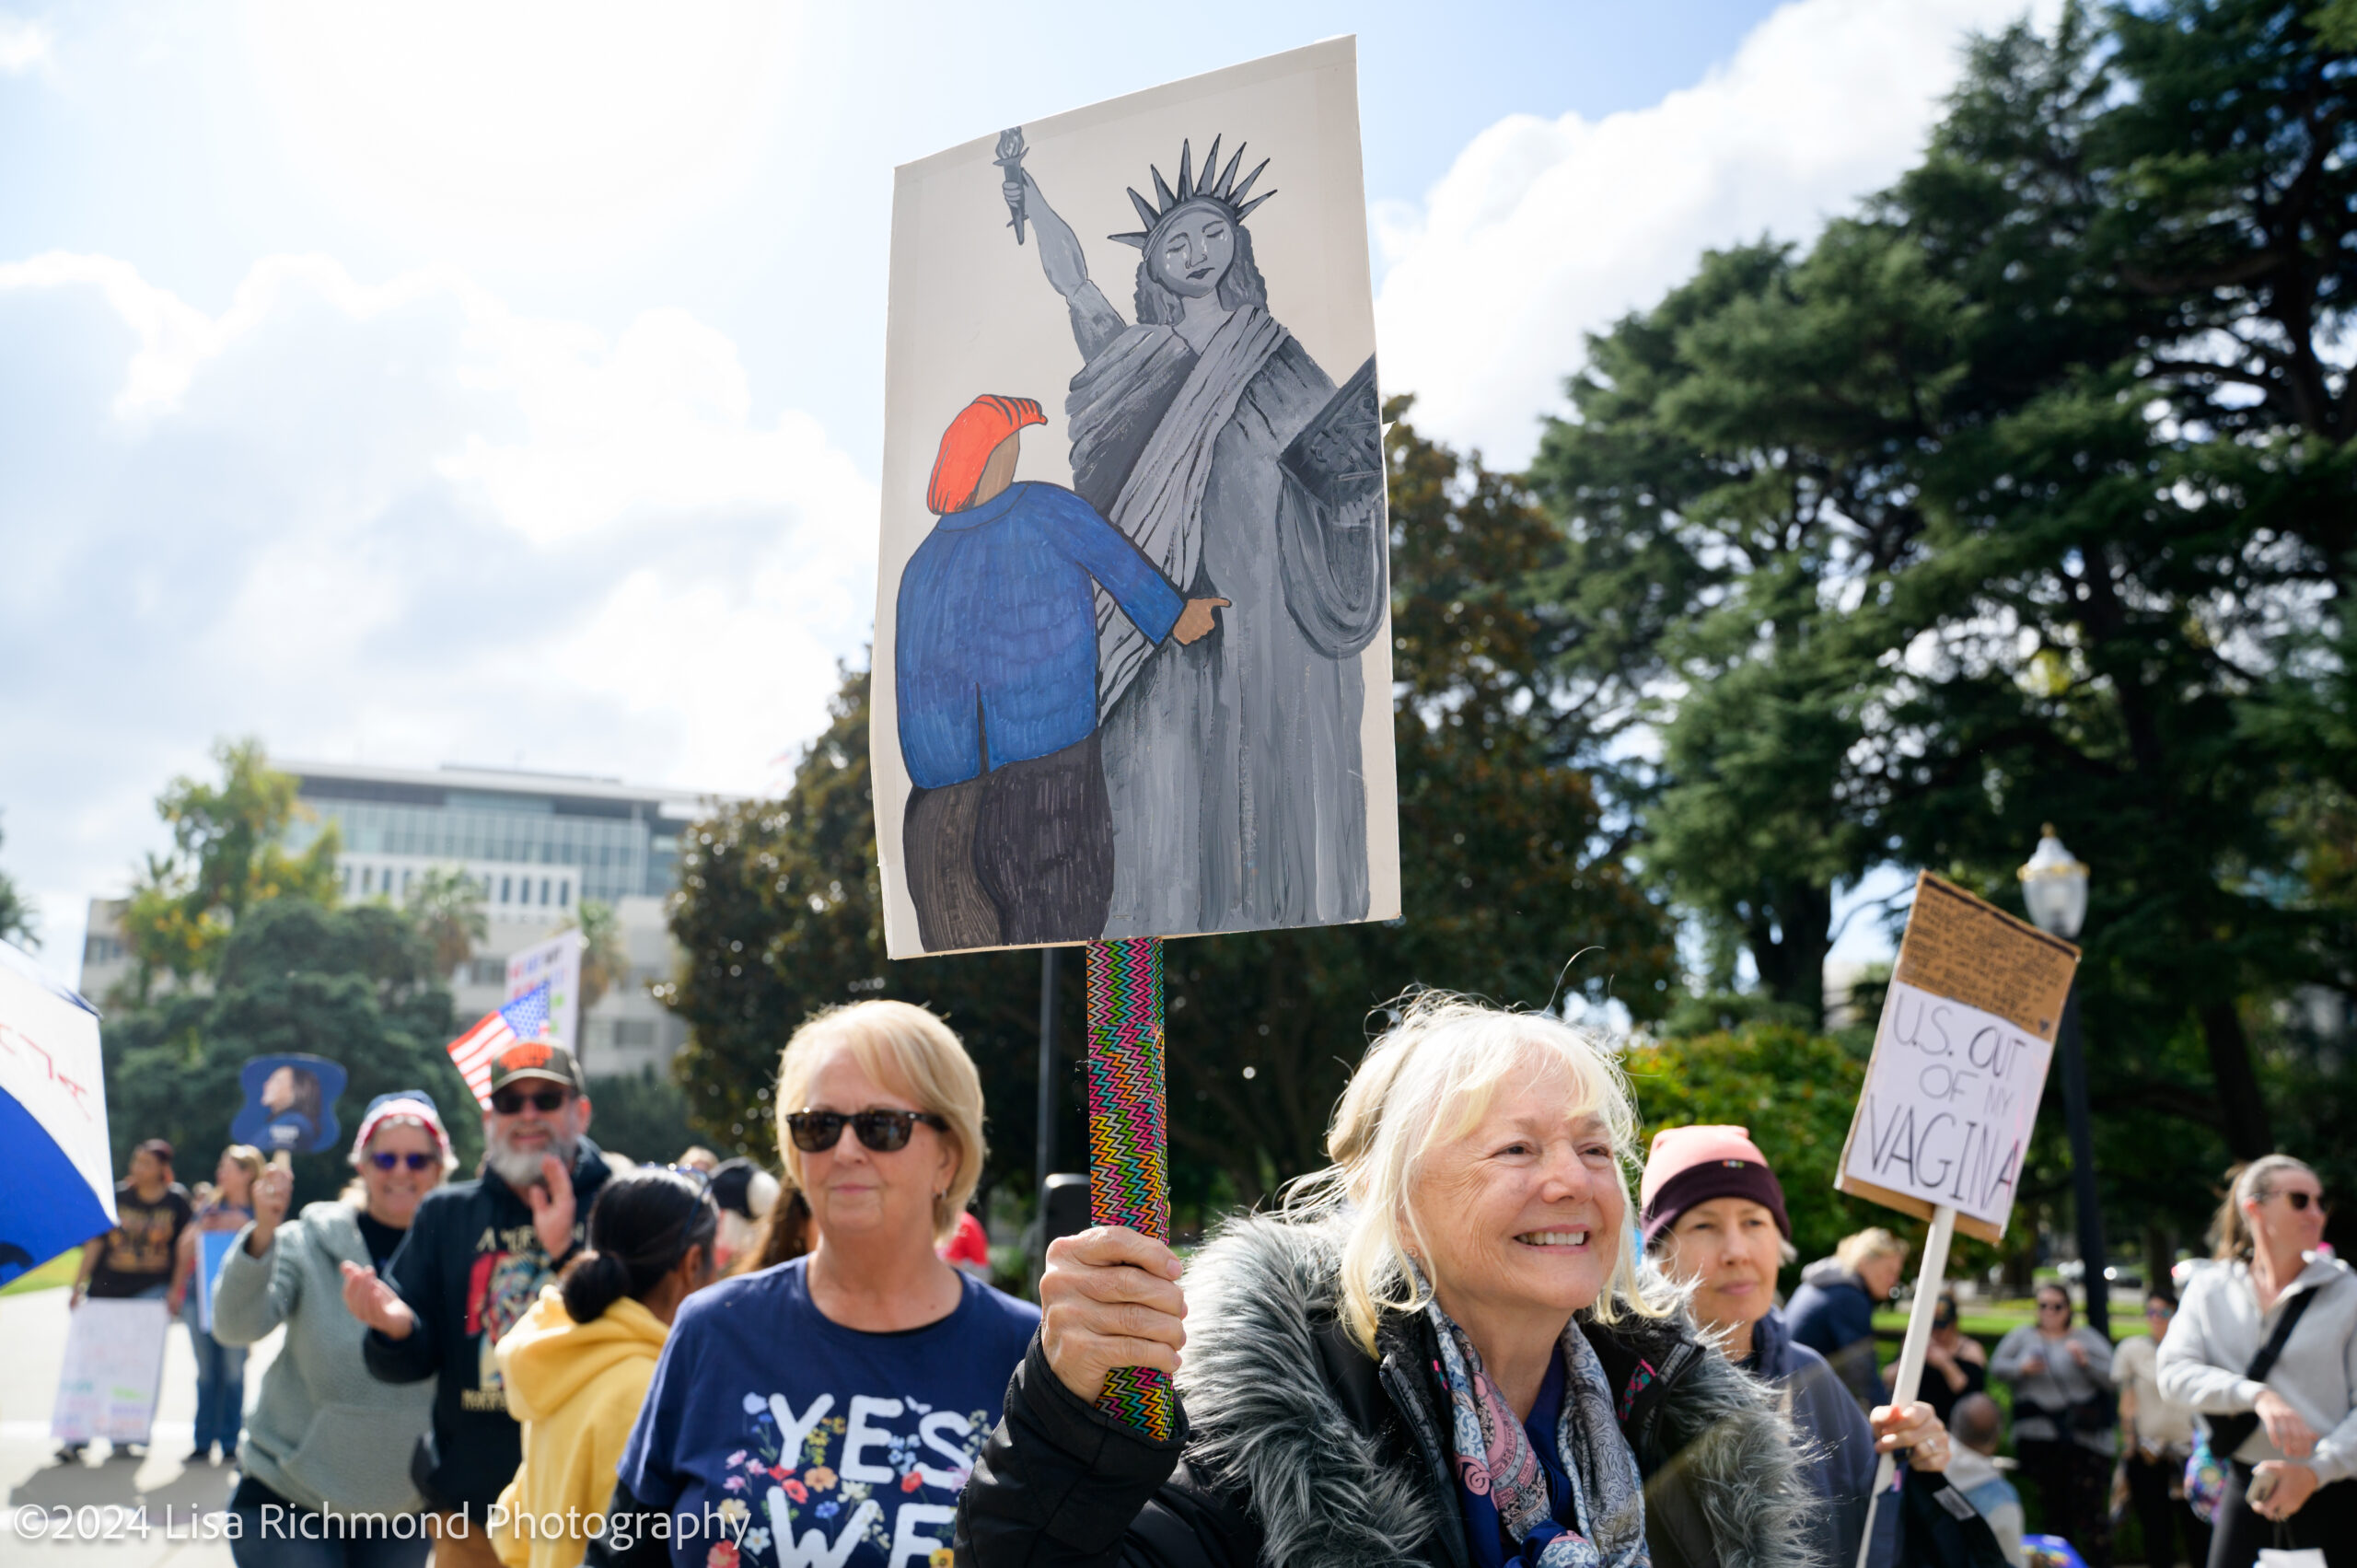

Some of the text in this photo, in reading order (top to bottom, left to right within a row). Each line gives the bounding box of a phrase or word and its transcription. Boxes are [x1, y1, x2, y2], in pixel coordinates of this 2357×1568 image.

[1893, 993, 1953, 1056] U.S.
[1919, 1063, 1980, 1103] OF
[1870, 1093, 2021, 1212] VAGINA
[769, 1393, 972, 1489] YES
